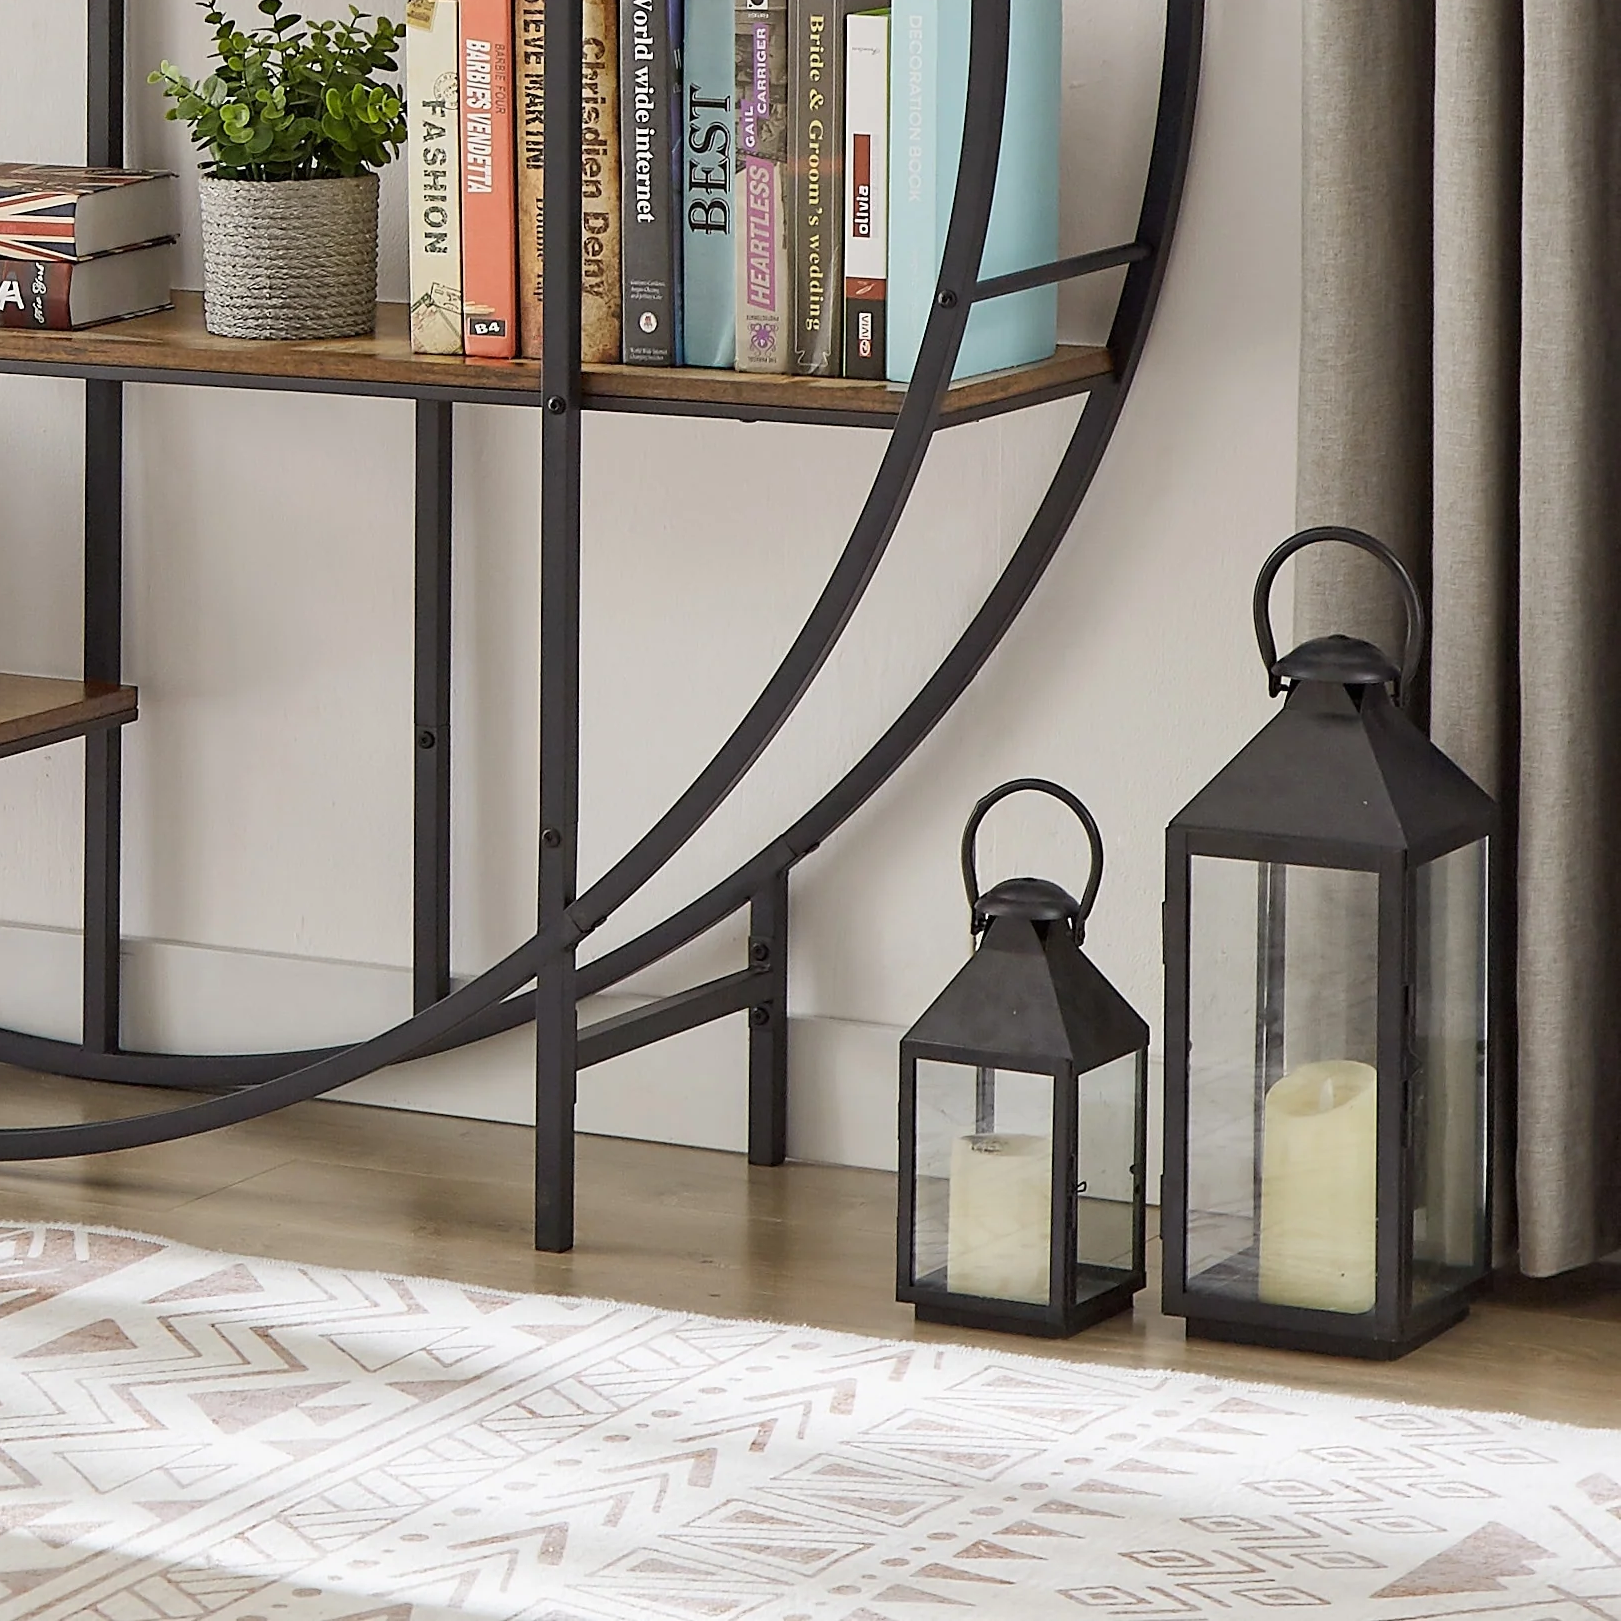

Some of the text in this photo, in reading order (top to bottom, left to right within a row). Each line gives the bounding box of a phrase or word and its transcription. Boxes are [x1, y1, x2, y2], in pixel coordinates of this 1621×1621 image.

[494, 43, 505, 115] BARBIE FOUR
[632, 61, 654, 122] wide
[745, 27, 768, 149] GAIL CARRIGER
[907, 14, 922, 203] DECORATION BOOK
[421, 99, 447, 255] FASHION
[466, 112, 492, 194] VENDETTA
[637, 125, 656, 223] internet
[688, 83, 731, 237] BEST
[805, 14, 825, 332] Bride & Groom's wedding
[747, 164, 773, 310] HEARTLESS
[857, 183, 869, 235] olivia
[474, 322, 500, 335] B4
